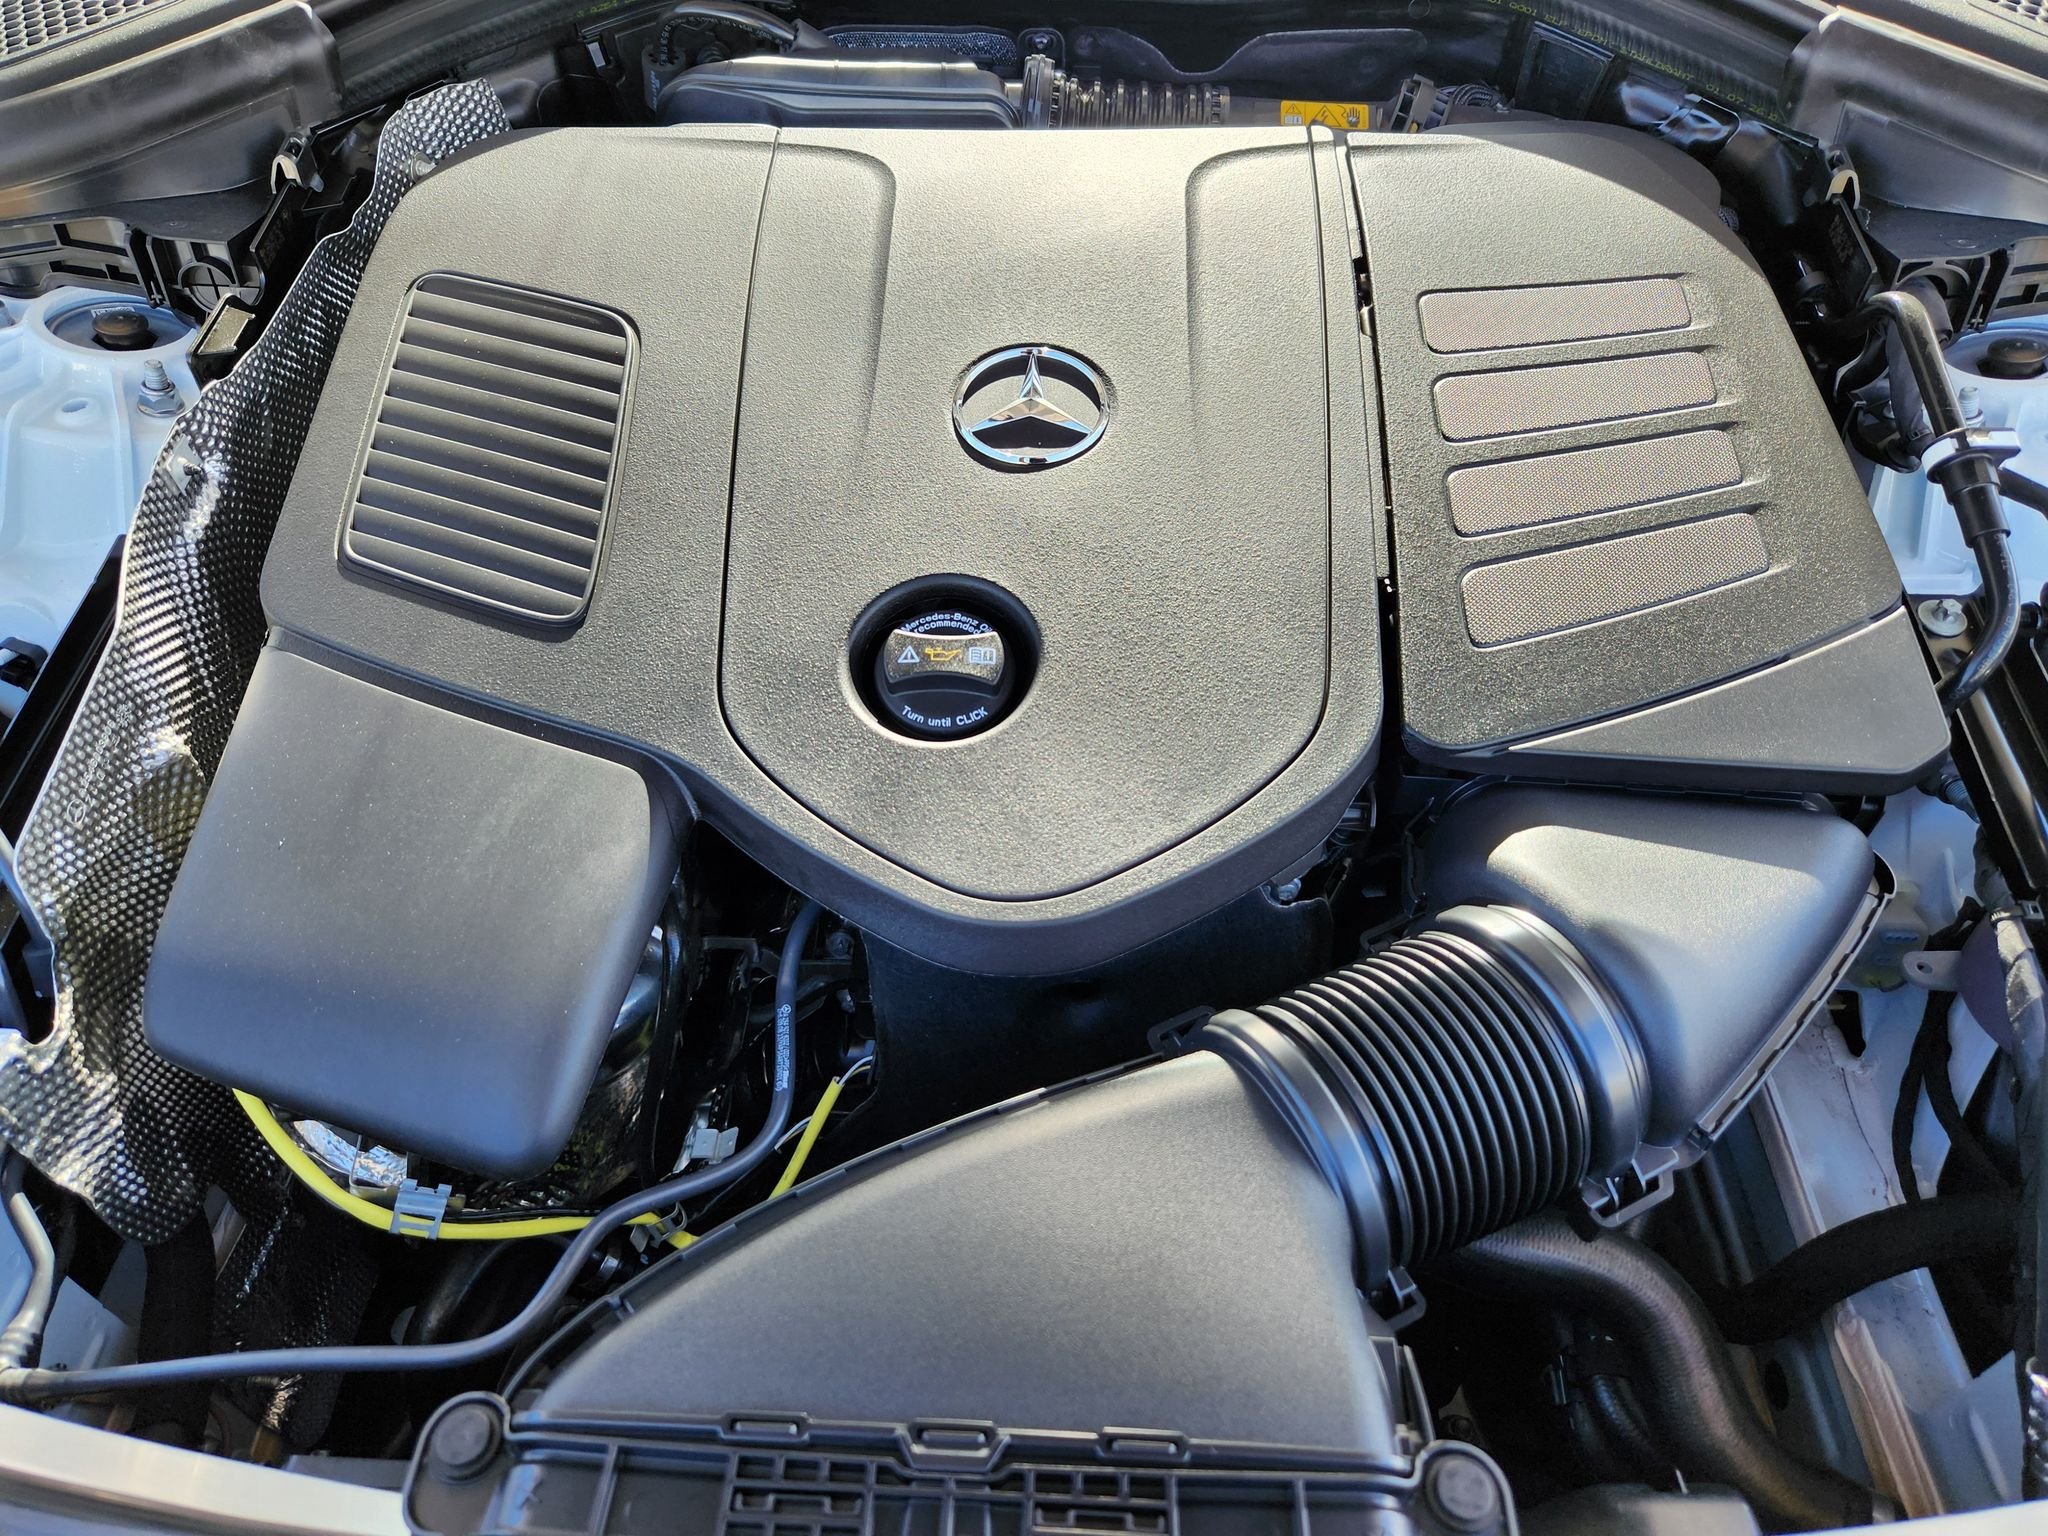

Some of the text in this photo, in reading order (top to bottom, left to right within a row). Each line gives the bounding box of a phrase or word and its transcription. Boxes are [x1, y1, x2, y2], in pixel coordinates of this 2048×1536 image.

[901, 613, 979, 632] Mercedes-Benz
[914, 620, 981, 634] recommended
[902, 705, 988, 727] Turn until CLICK
